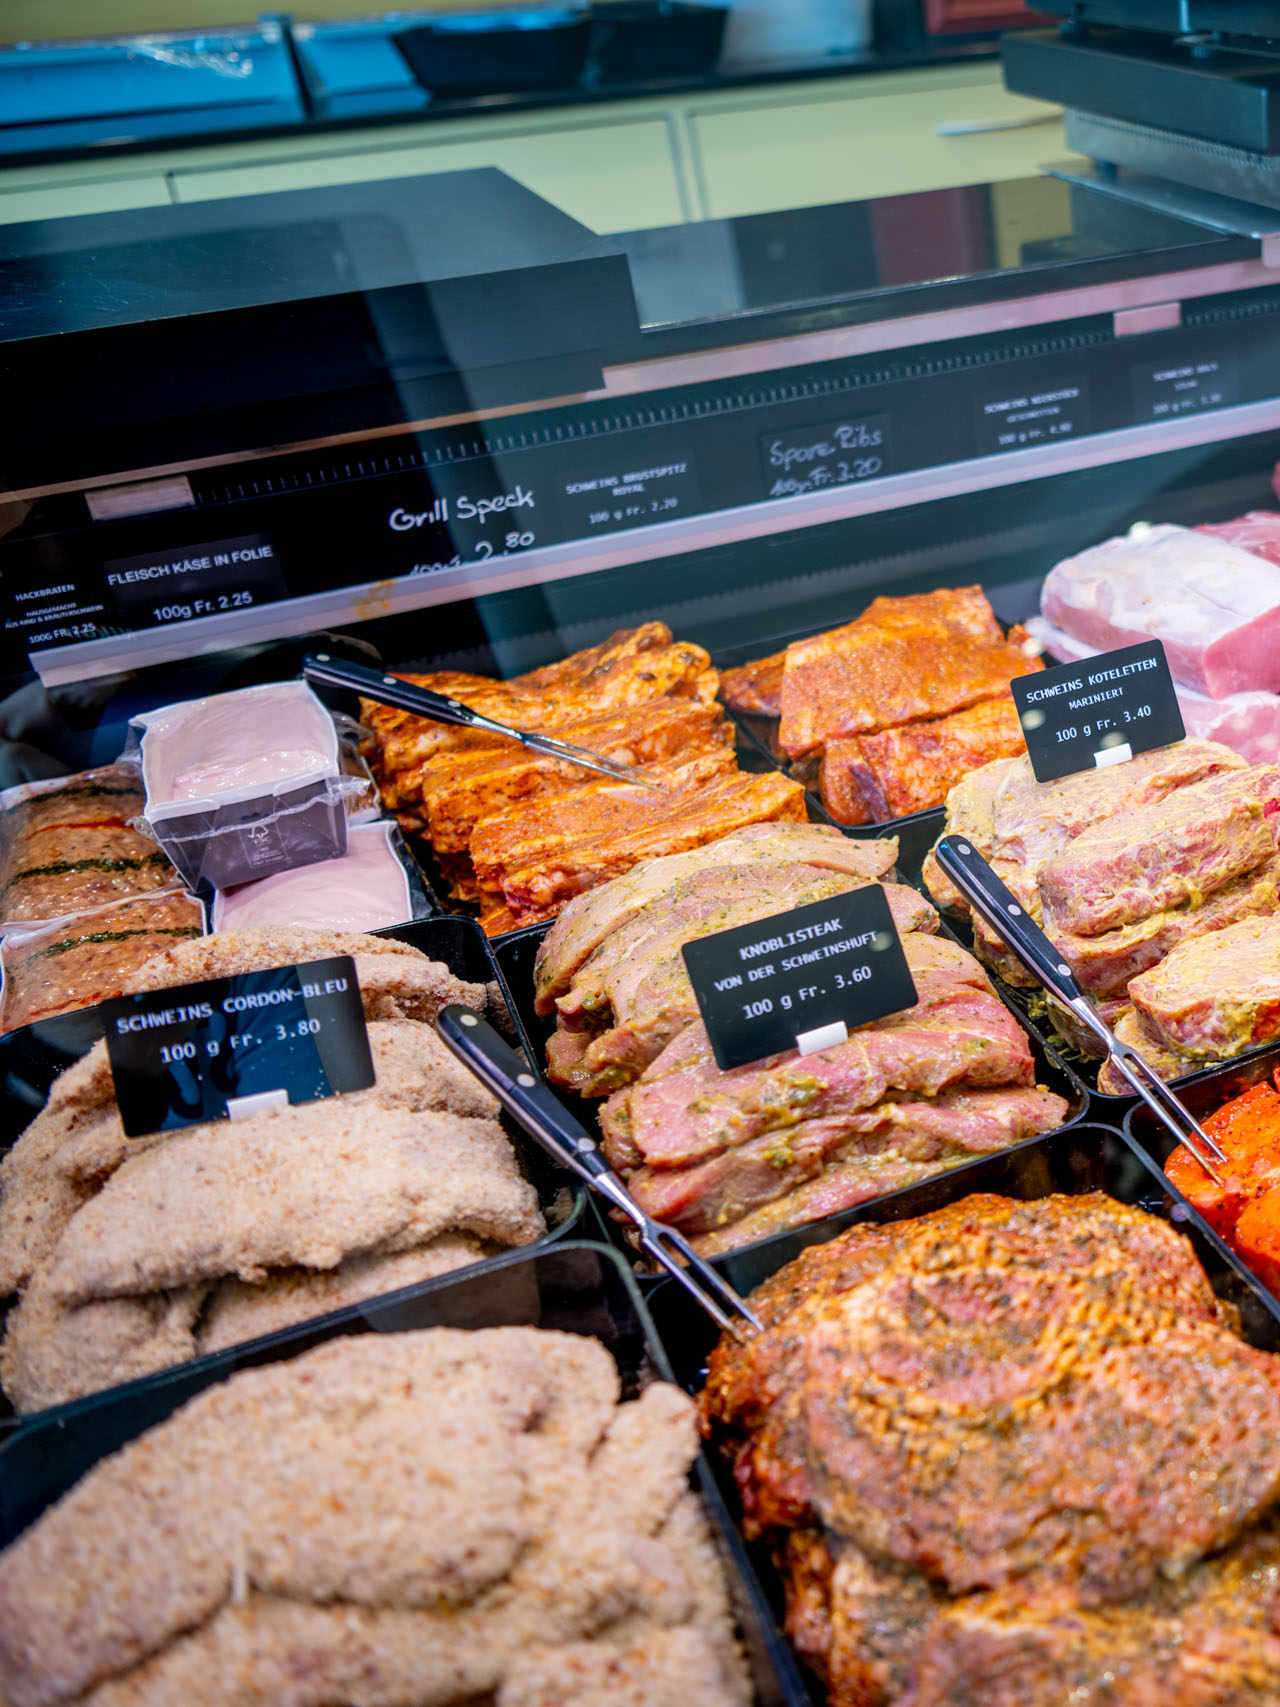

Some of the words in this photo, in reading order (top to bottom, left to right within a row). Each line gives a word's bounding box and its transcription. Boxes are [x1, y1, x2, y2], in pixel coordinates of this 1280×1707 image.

[770, 440, 836, 472] Spare
[834, 424, 882, 449] Ribs
[565, 476, 619, 494] SCHWEINS
[622, 462, 687, 483] BRUSTSPITZ
[837, 456, 882, 482] 3.20
[389, 497, 448, 531] Grill
[456, 485, 535, 524] Speck
[612, 483, 645, 496] ROYAL
[589, 511, 610, 524] 100
[613, 510, 622, 521] g
[626, 507, 645, 517] Fr.
[651, 497, 677, 512] 2.20
[107, 565, 170, 585] FLEISCH
[172, 556, 211, 575] KÄSE
[214, 554, 230, 567] IN
[232, 545, 273, 563] FOLIE
[14, 584, 75, 601] HACKBRATEN
[153, 604, 192, 621] 100g
[194, 599, 215, 613] Fr.
[218, 591, 253, 609] 2.25
[28, 633, 53, 644] 100G
[72, 622, 96, 635] 2.25
[1026, 679, 1083, 704] SCHWEINS
[1088, 657, 1158, 687] KOTELETTEN
[1068, 687, 1124, 710] MARINIERT
[1056, 727, 1077, 743] 100
[1083, 724, 1091, 736] g
[1097, 719, 1117, 731] Fr.
[1123, 705, 1151, 723] 3.40
[738, 918, 843, 961] KNOBLISTEAK
[714, 975, 743, 992] VON
[748, 965, 776, 982] DER
[781, 931, 878, 972] SCHWEINSHUFT
[116, 1002, 213, 1034] SCHWEINS
[222, 978, 348, 1013] CORDON-BLEU
[742, 998, 774, 1020] 100
[780, 994, 793, 1010] g
[798, 986, 827, 1001] Fr.
[834, 966, 872, 990] 3.60
[160, 1043, 196, 1063] 100
[207, 1040, 219, 1057] g
[230, 1033, 262, 1050] Fr.
[275, 1018, 321, 1042] 3.80
